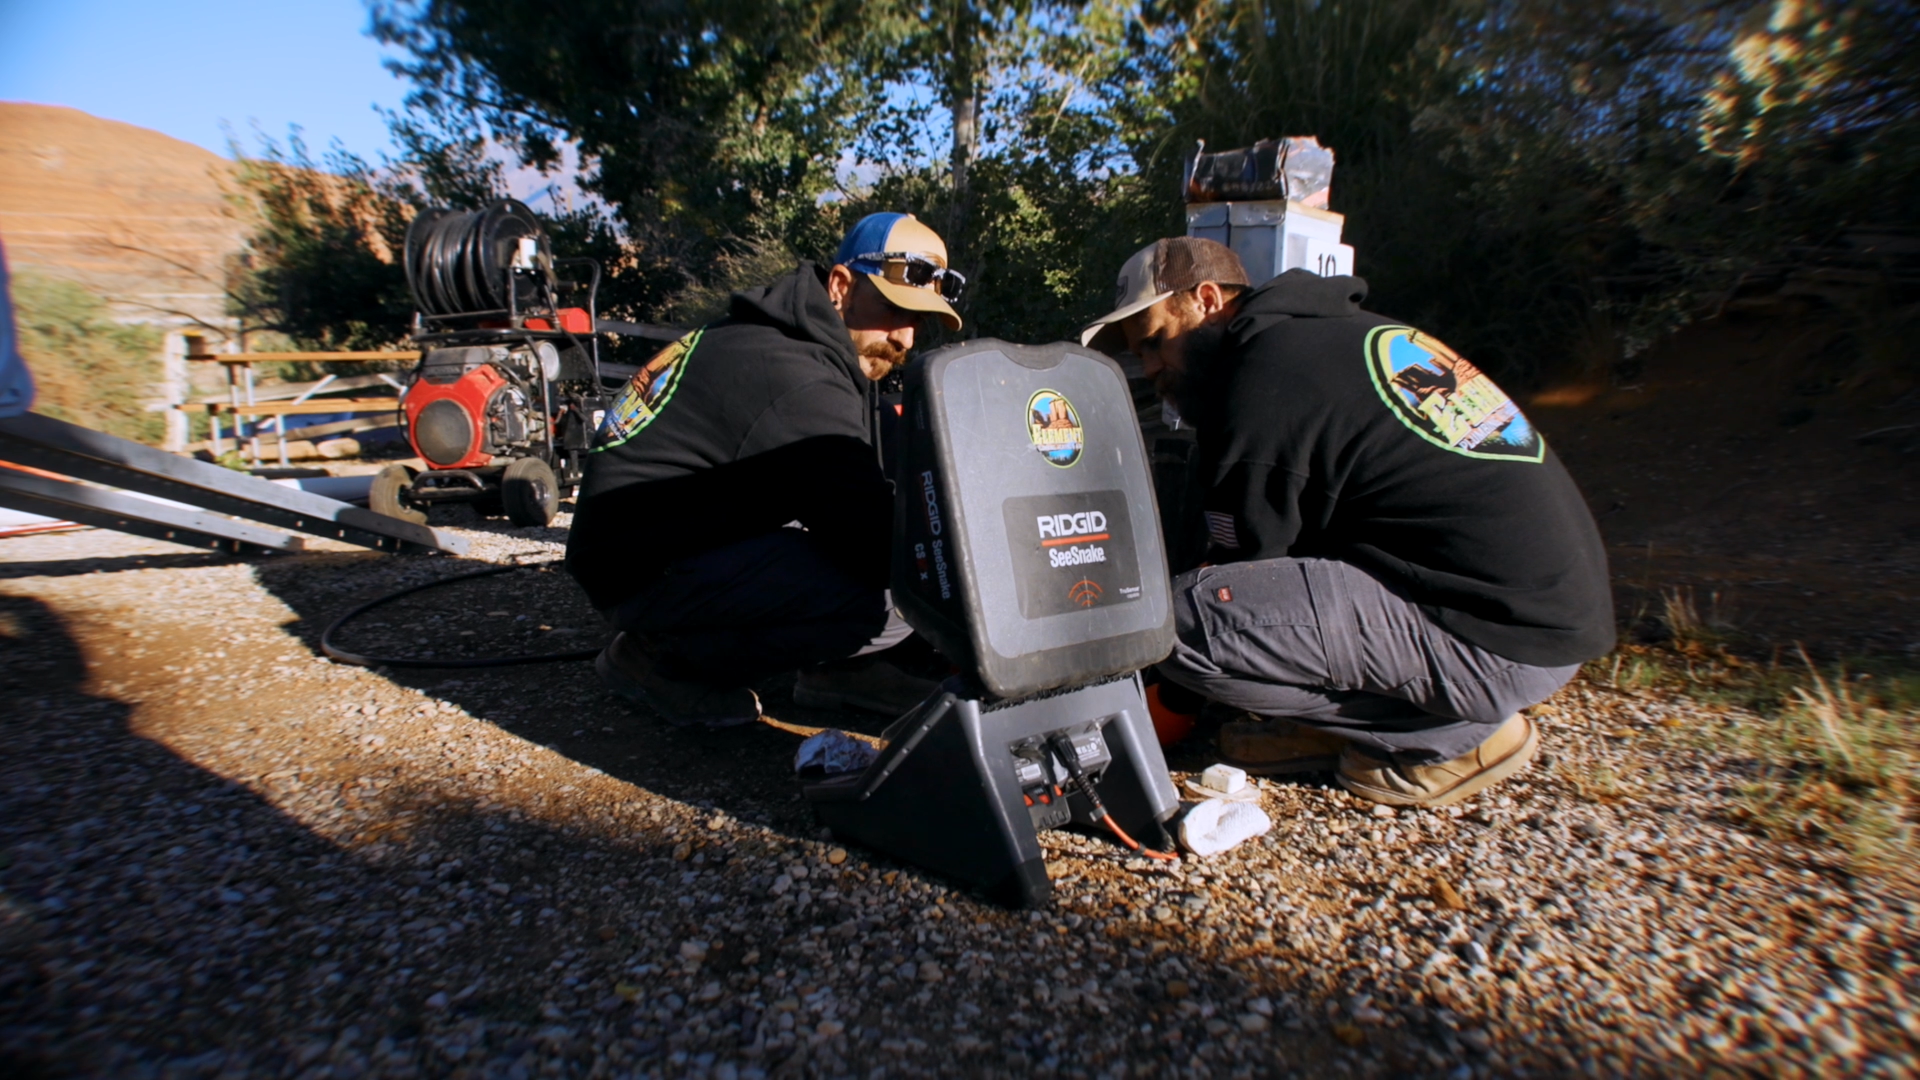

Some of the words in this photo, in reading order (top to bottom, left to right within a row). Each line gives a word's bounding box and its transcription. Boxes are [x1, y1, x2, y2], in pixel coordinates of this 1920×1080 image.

[921, 469, 942, 536] RIDGID
[932, 538, 951, 601] SeeSnake
[1037, 511, 1107, 539] RIDGID
[1049, 544, 1105, 568] SeeSnake
